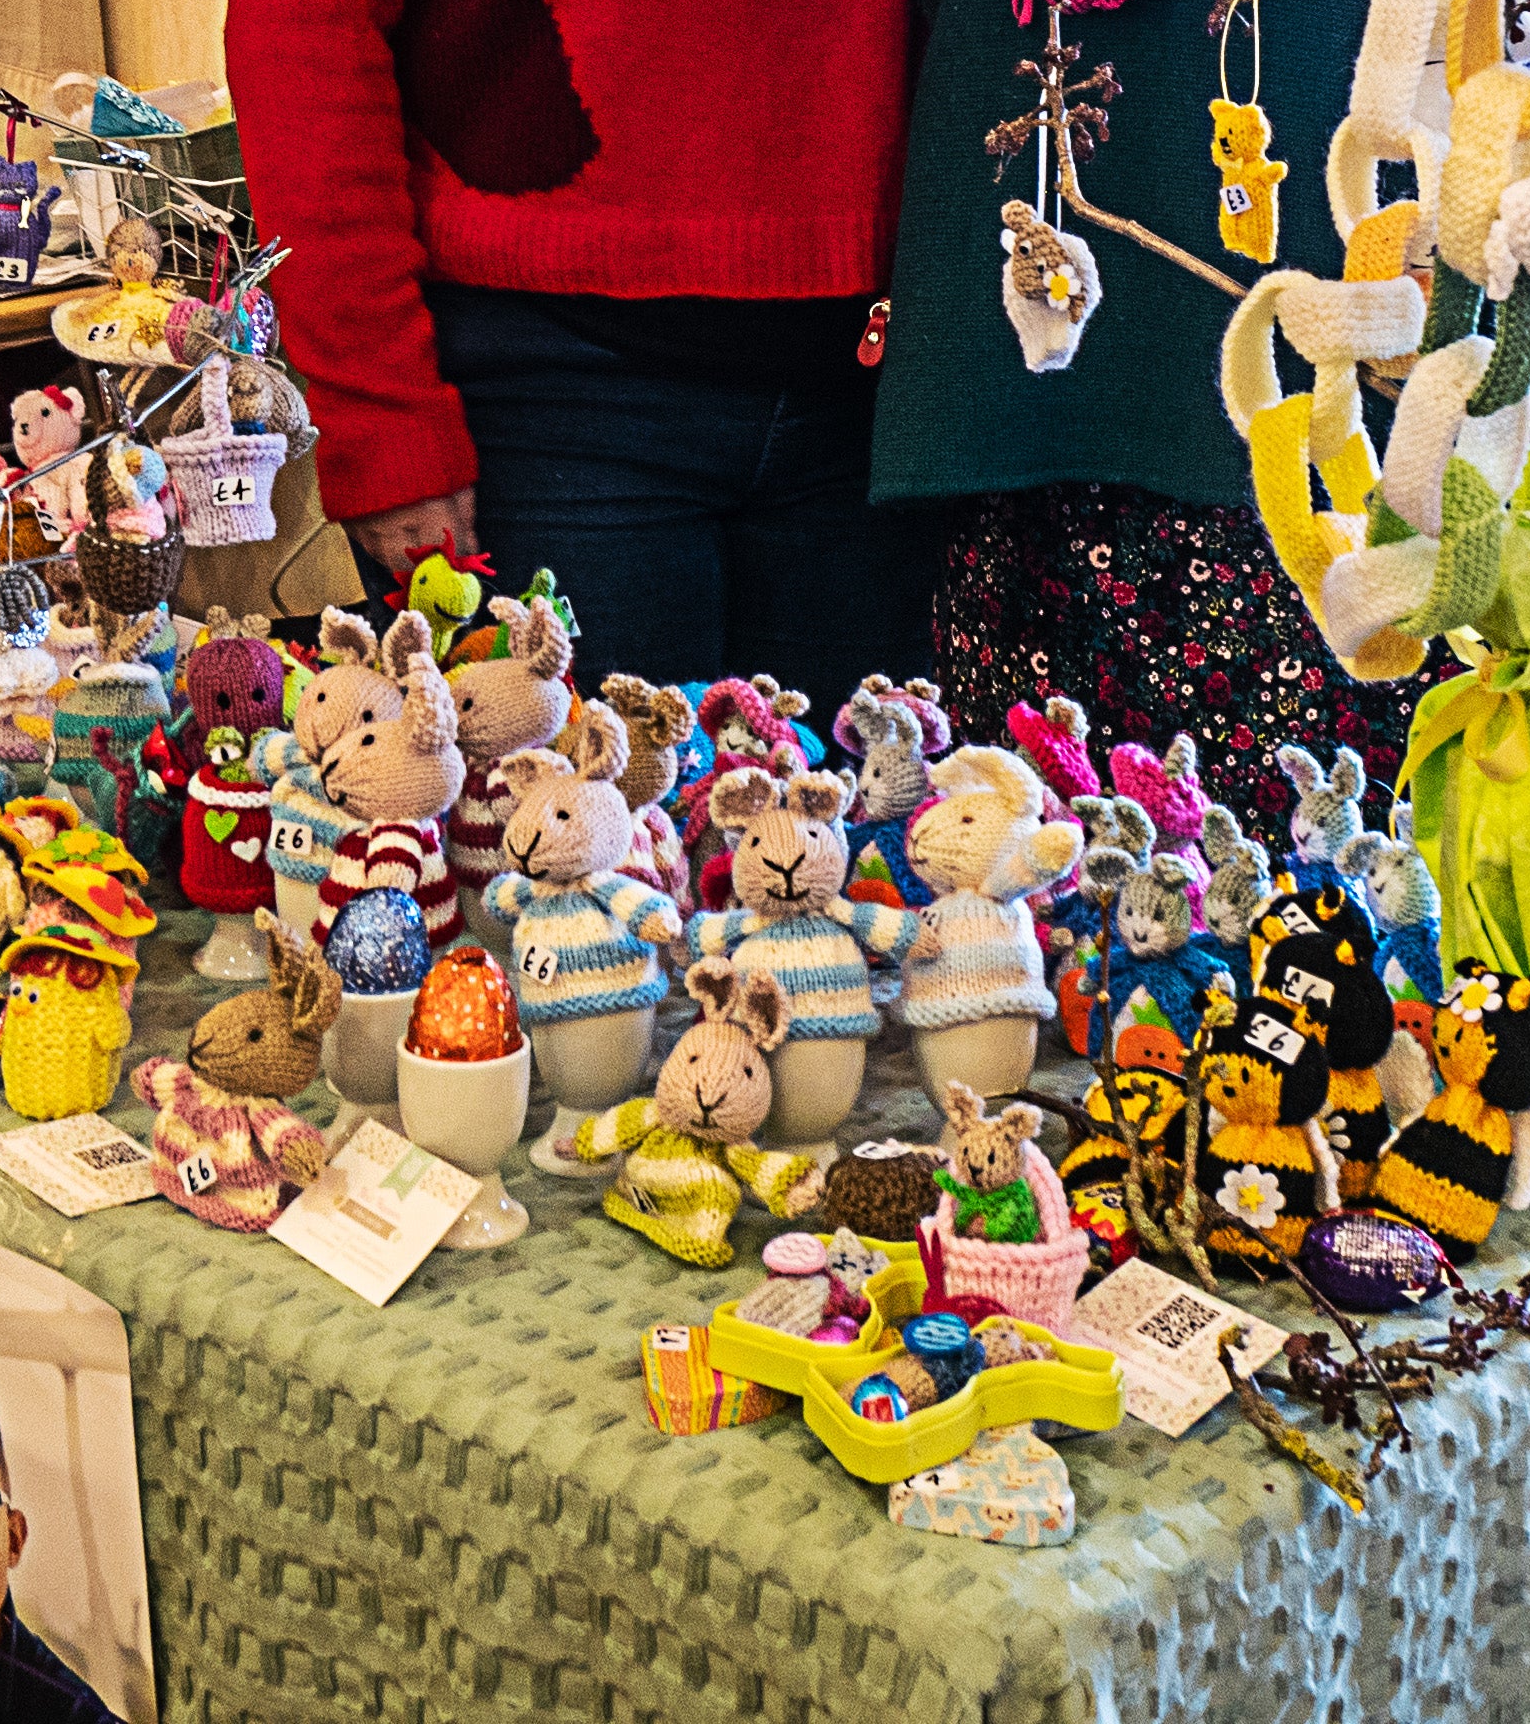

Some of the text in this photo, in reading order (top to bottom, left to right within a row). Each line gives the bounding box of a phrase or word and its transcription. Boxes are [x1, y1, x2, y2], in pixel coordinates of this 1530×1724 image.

[215, 479, 251, 502] £4
[274, 828, 304, 851] £6
[524, 947, 554, 980] £6
[1250, 1014, 1287, 1052] £6
[186, 1157, 211, 1194] £6
